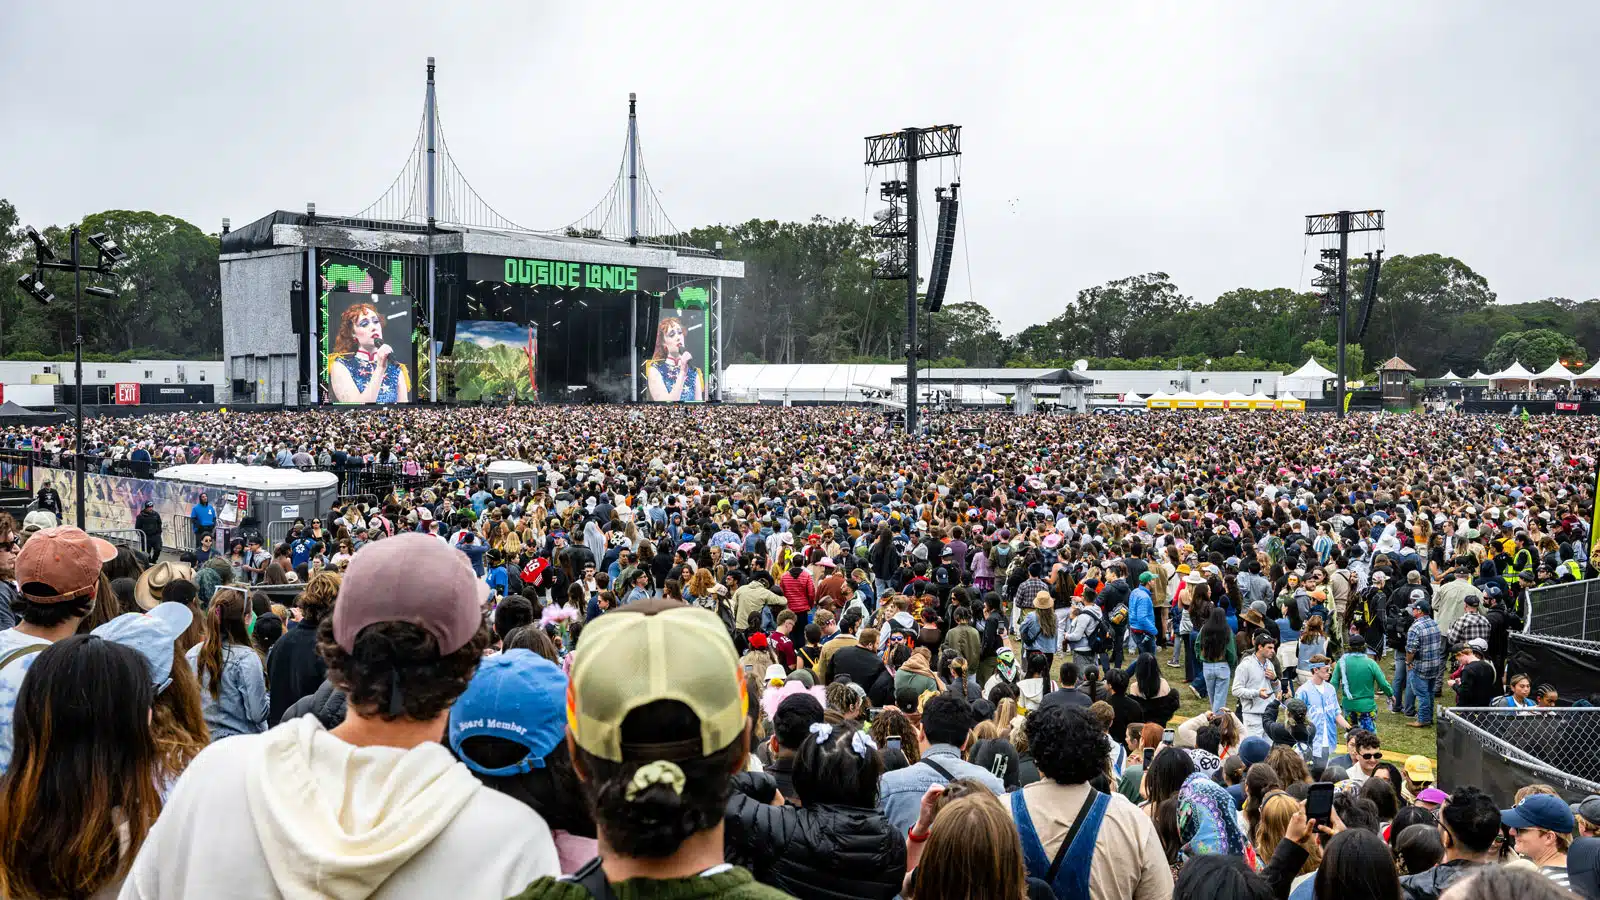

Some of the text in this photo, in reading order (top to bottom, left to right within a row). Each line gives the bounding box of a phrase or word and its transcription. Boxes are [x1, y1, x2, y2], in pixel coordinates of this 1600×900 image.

[504, 258, 637, 290] OUTSIDE LANDS
[119, 388, 136, 401] EXIT
[487, 719, 527, 735] Member
